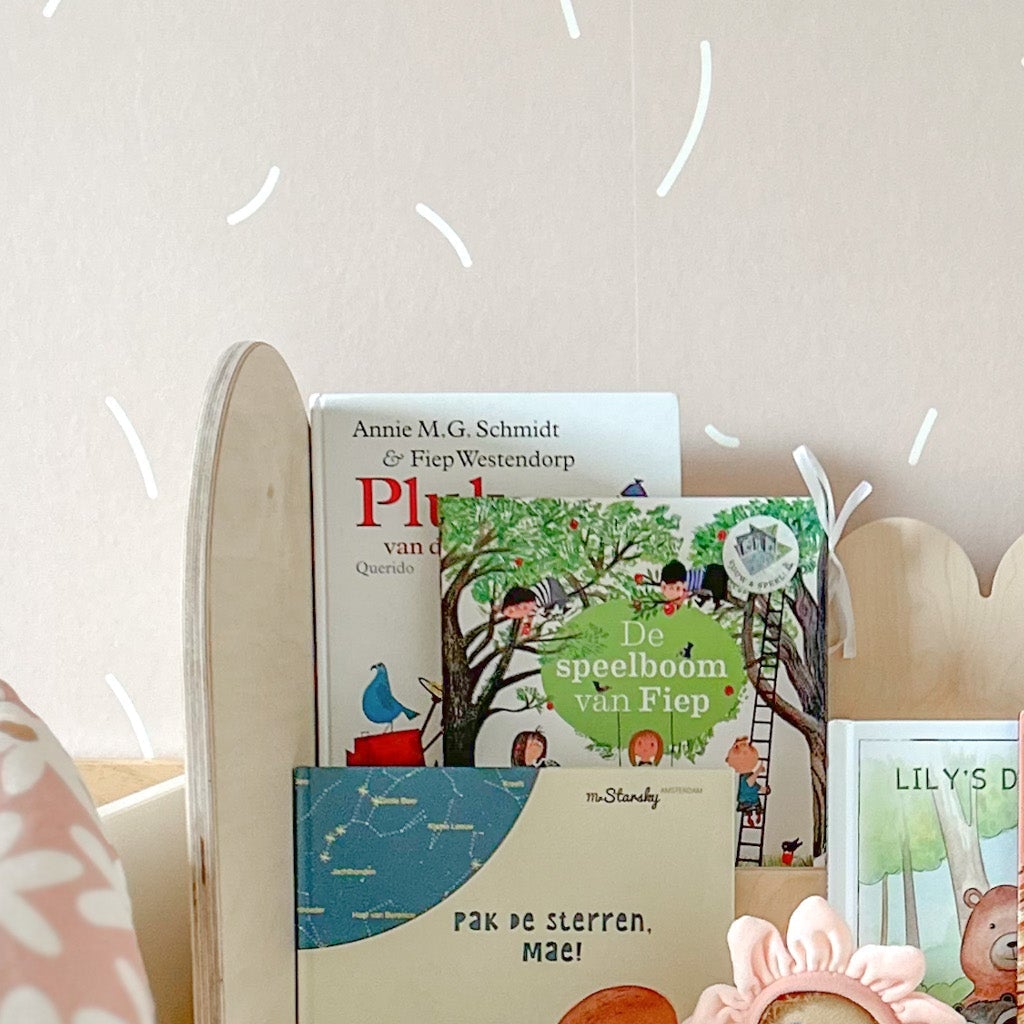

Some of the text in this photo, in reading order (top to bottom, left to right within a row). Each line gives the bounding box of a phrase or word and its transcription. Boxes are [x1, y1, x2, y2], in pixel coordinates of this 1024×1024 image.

[352, 420, 560, 439] Annie M.G. Schmidt
[383, 449, 576, 472] & Fiep Westendorp
[384, 541, 423, 555] van
[356, 560, 415, 577] Querido
[621, 621, 664, 647] De
[556, 651, 728, 683] speelboom
[575, 686, 710, 718] van Fiep
[896, 768, 987, 790] LILY'S
[522, 941, 582, 962] Mae!
